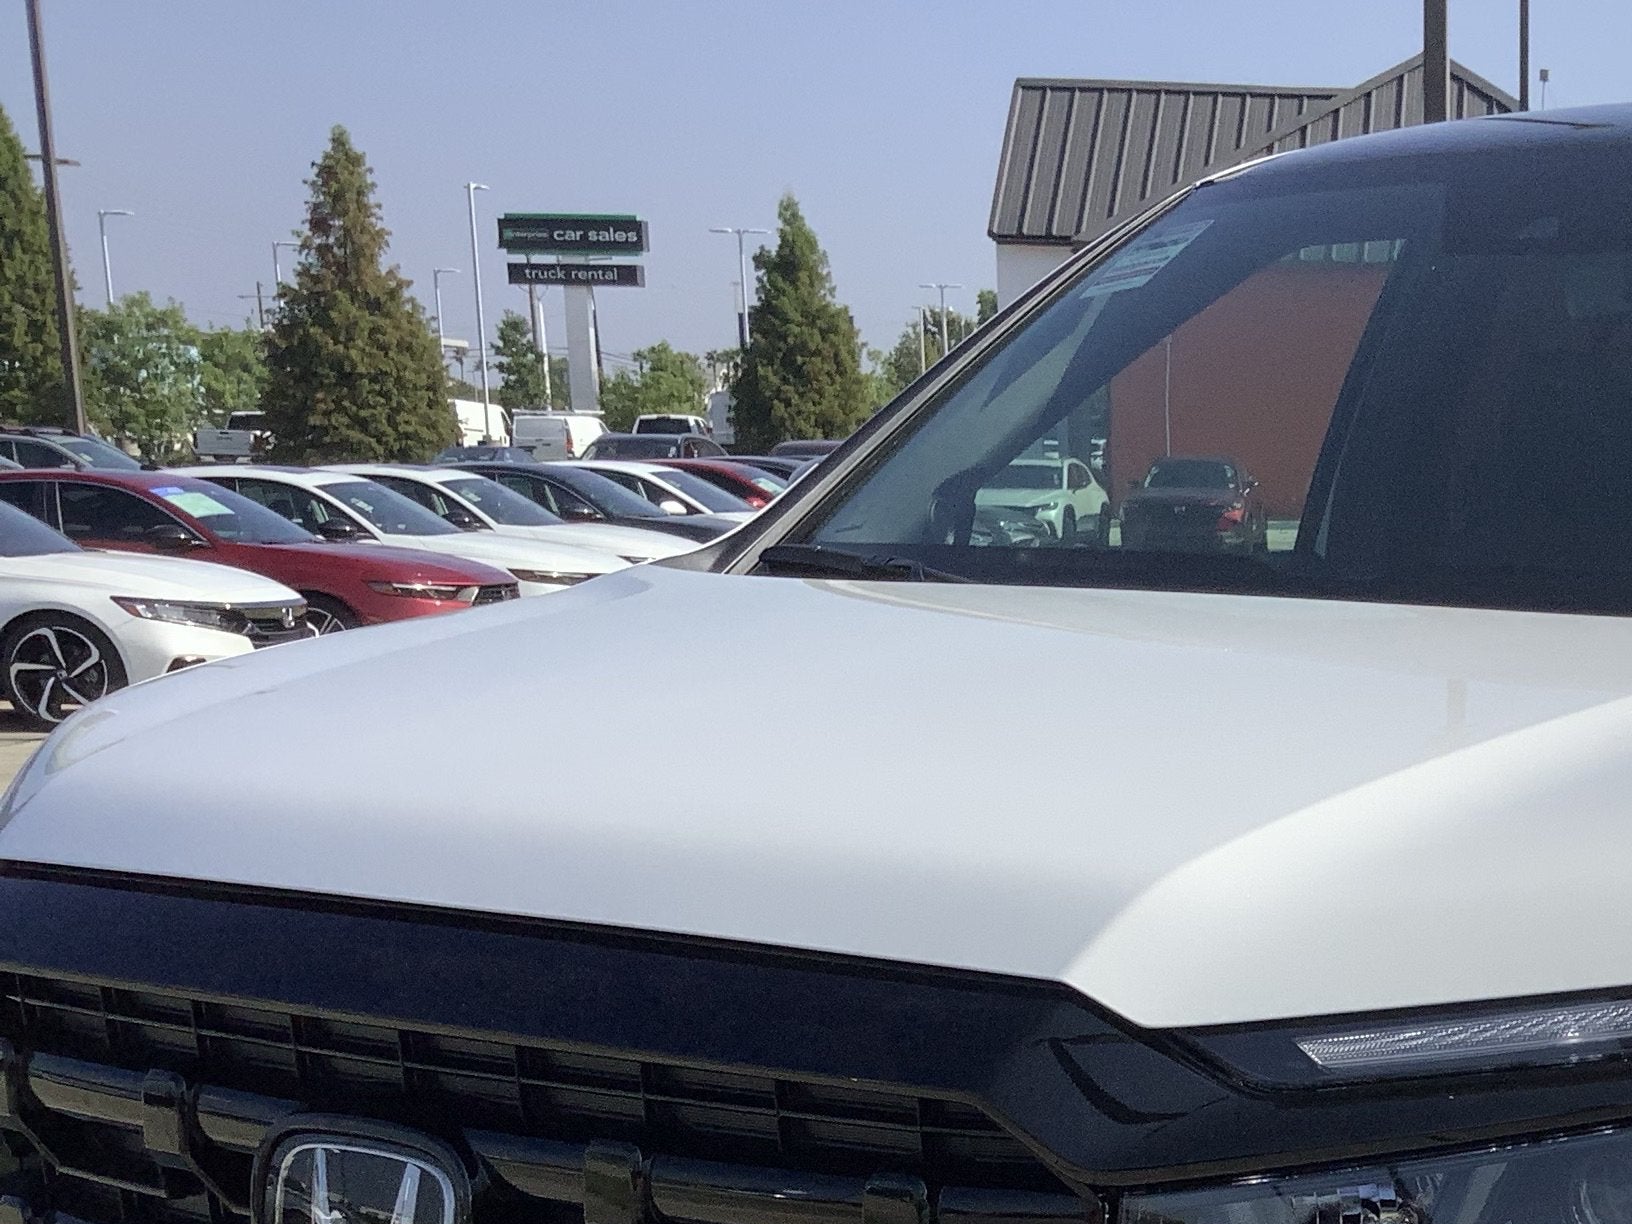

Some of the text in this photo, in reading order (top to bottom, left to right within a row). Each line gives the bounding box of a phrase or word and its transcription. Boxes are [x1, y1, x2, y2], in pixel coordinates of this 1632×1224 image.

[553, 229, 584, 241] car
[588, 226, 638, 242] sales
[525, 266, 618, 281] truck rental
